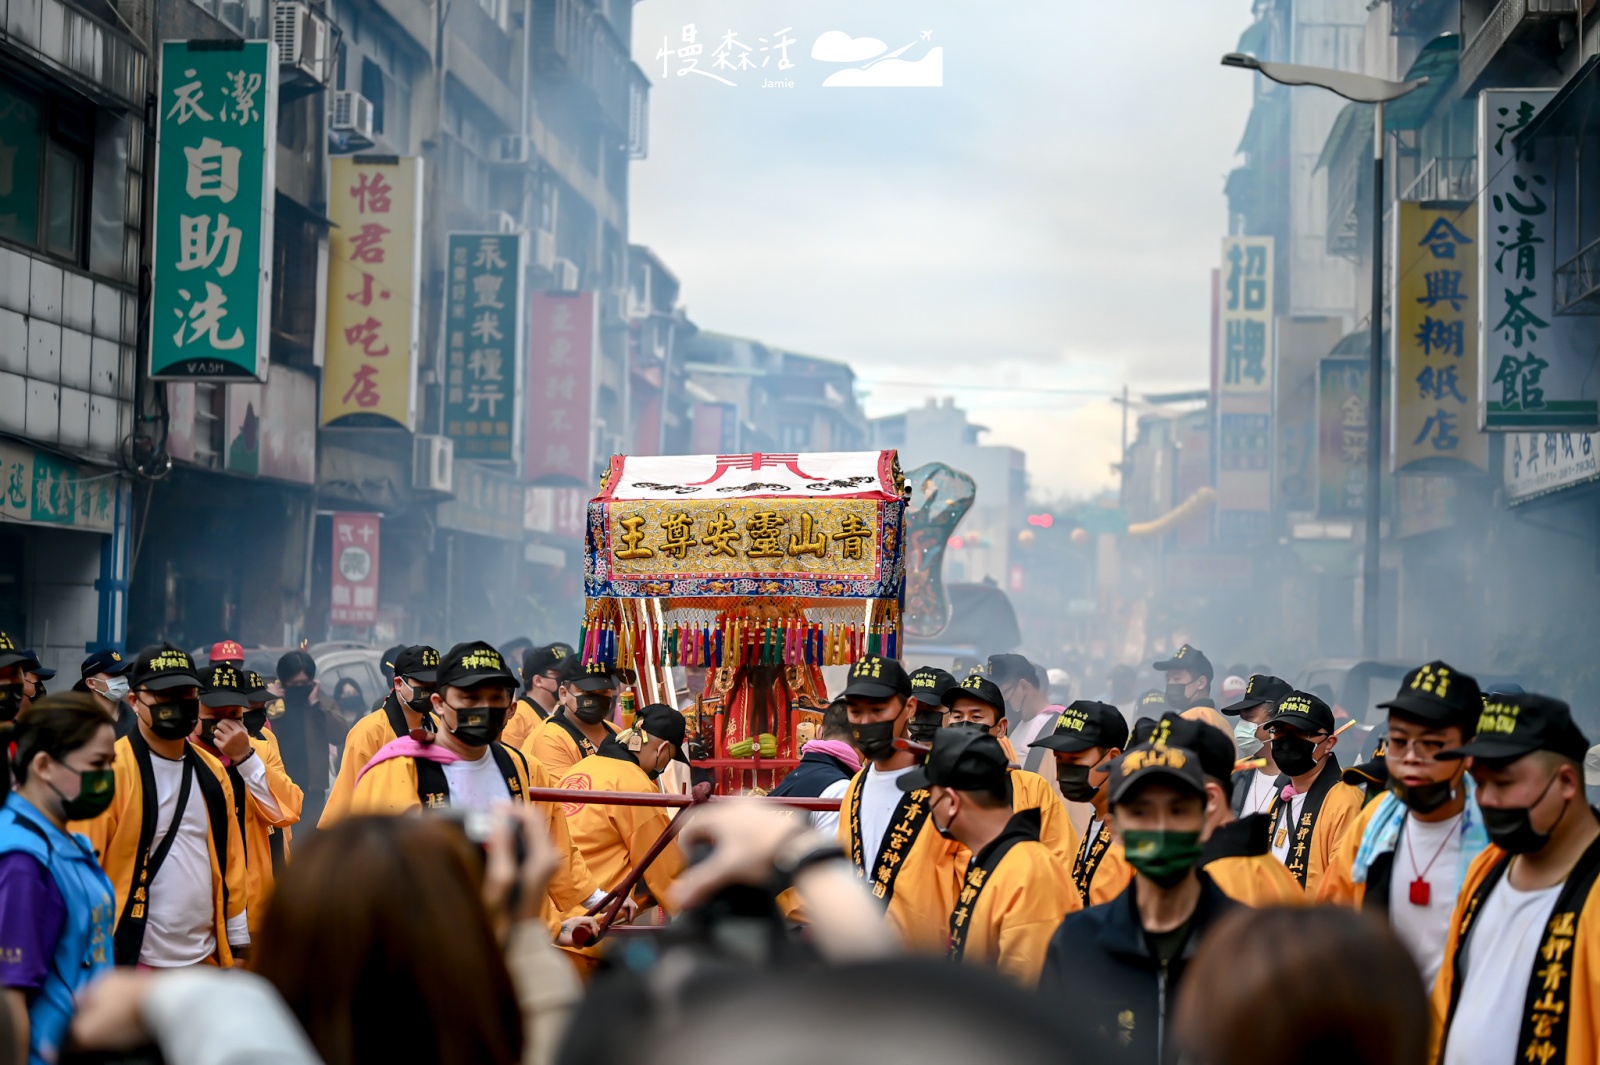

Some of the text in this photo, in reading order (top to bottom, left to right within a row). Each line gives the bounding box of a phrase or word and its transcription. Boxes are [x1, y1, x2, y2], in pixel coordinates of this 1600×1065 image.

[173, 136, 244, 350] 自助洗
[342, 172, 393, 408] 怡君小吃店
[468, 238, 507, 418] 永豐米糧行
[1224, 243, 1267, 386] 招牌
[1413, 216, 1474, 453] 合興糊紙店
